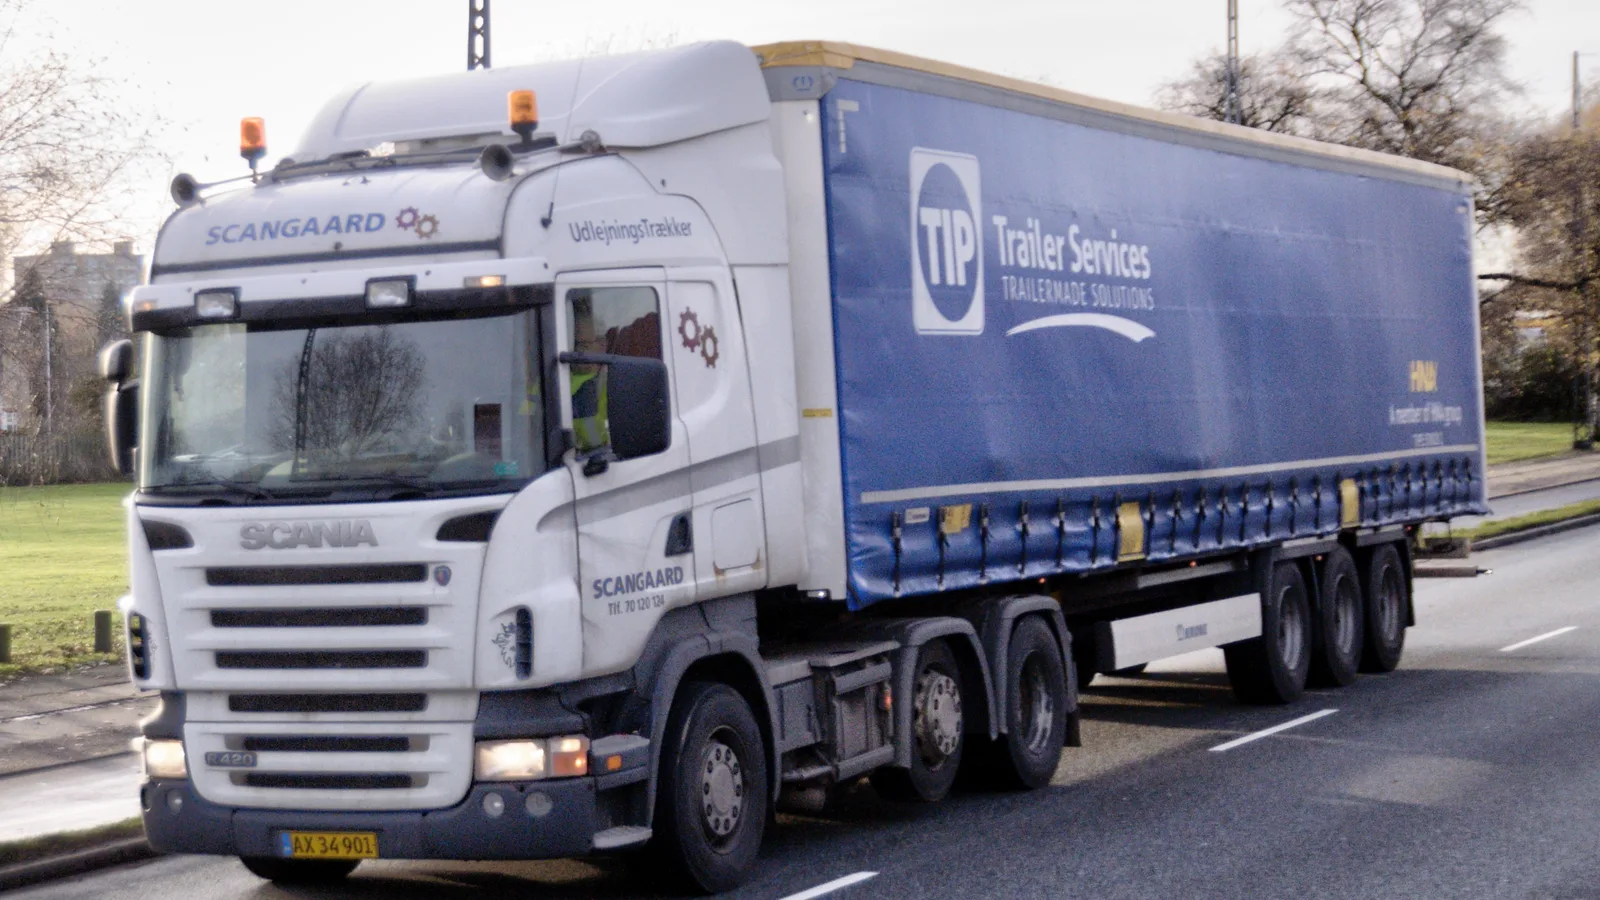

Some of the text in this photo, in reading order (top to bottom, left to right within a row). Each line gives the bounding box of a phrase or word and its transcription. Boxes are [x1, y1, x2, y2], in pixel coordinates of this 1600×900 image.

[205, 212, 386, 246] SCANGAARD
[568, 216, 692, 246] UdlejningsTrækker
[920, 206, 976, 287] TIP
[992, 215, 1152, 280] Trailer Services
[1002, 275, 1155, 311] TRAILERMADE SOLUTIONS
[240, 519, 379, 550] SCANIA
[593, 566, 684, 599] SCANGAARD
